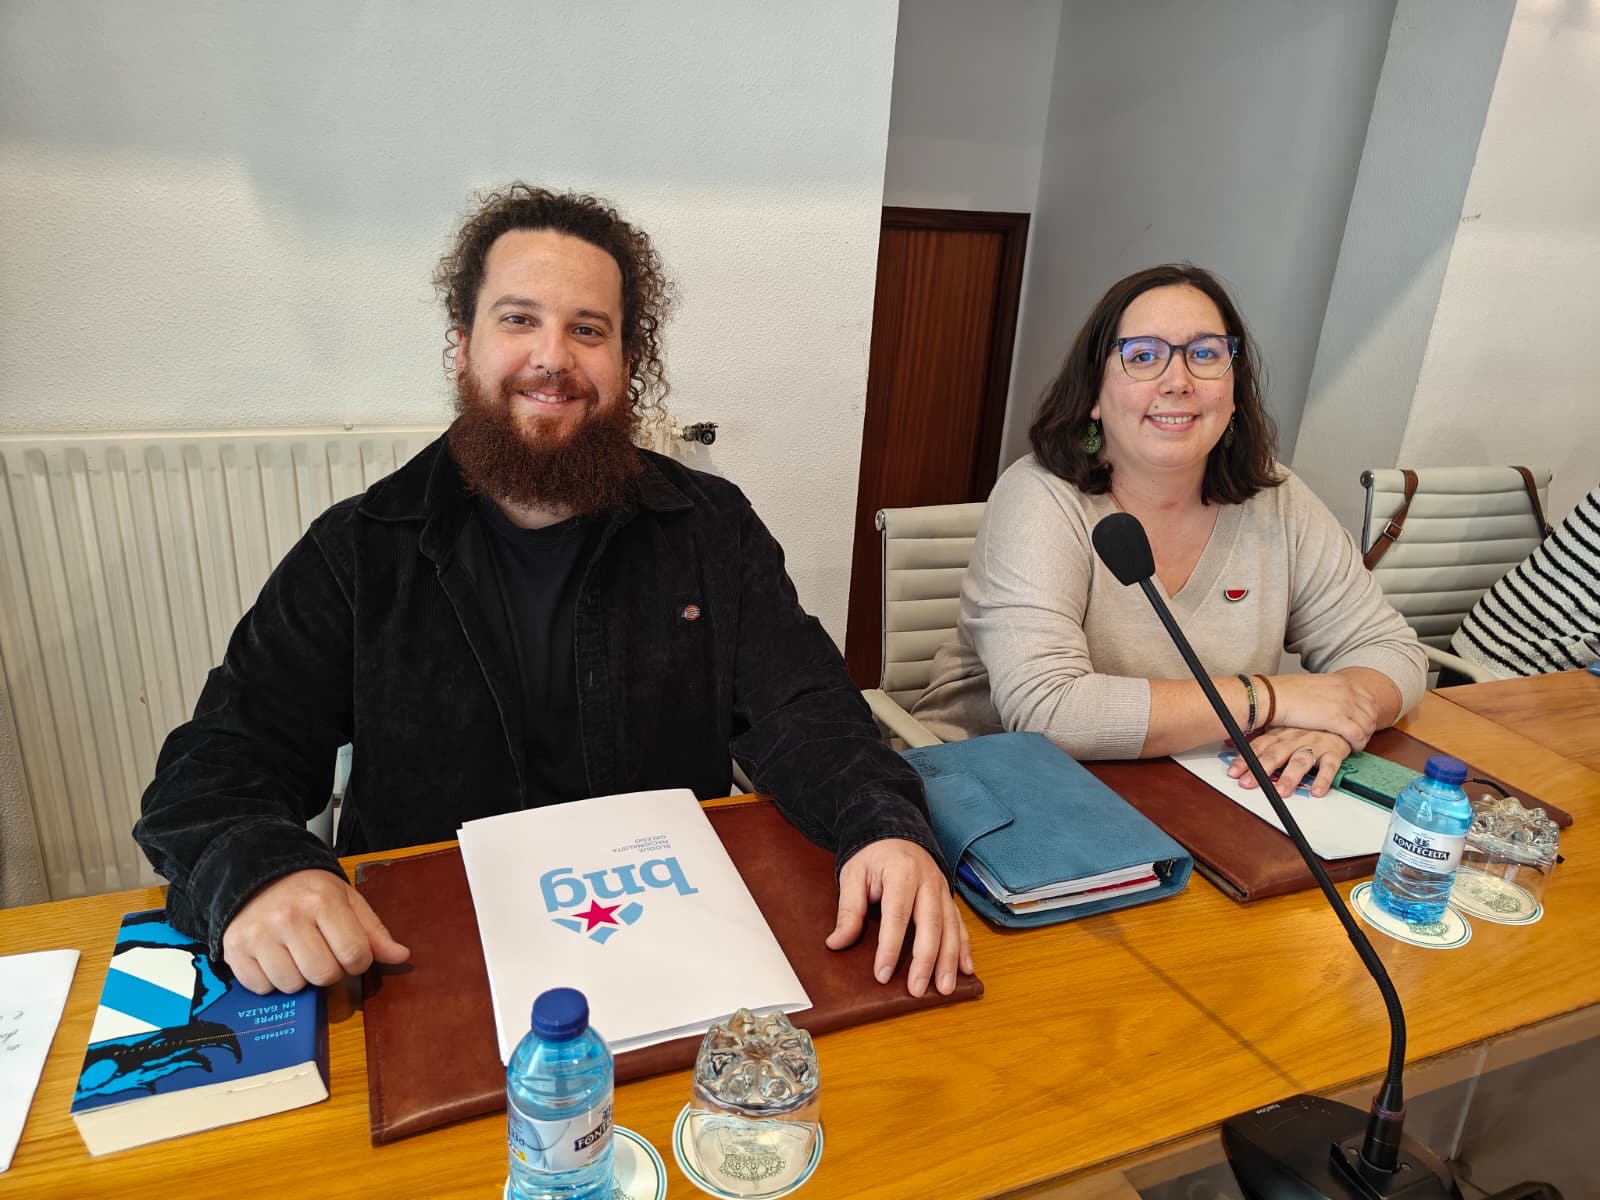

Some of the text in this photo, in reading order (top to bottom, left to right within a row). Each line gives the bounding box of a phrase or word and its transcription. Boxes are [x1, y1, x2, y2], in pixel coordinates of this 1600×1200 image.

[611, 839, 669, 853] NACIONALISTA
[634, 835, 667, 844] GALEGO
[1394, 834, 1449, 861] FONTECELTA
[539, 856, 699, 913] bng
[238, 1000, 296, 1018] EN GALIZA
[253, 1009, 296, 1025] SEMPRE
[254, 1027, 295, 1041] Castelao
